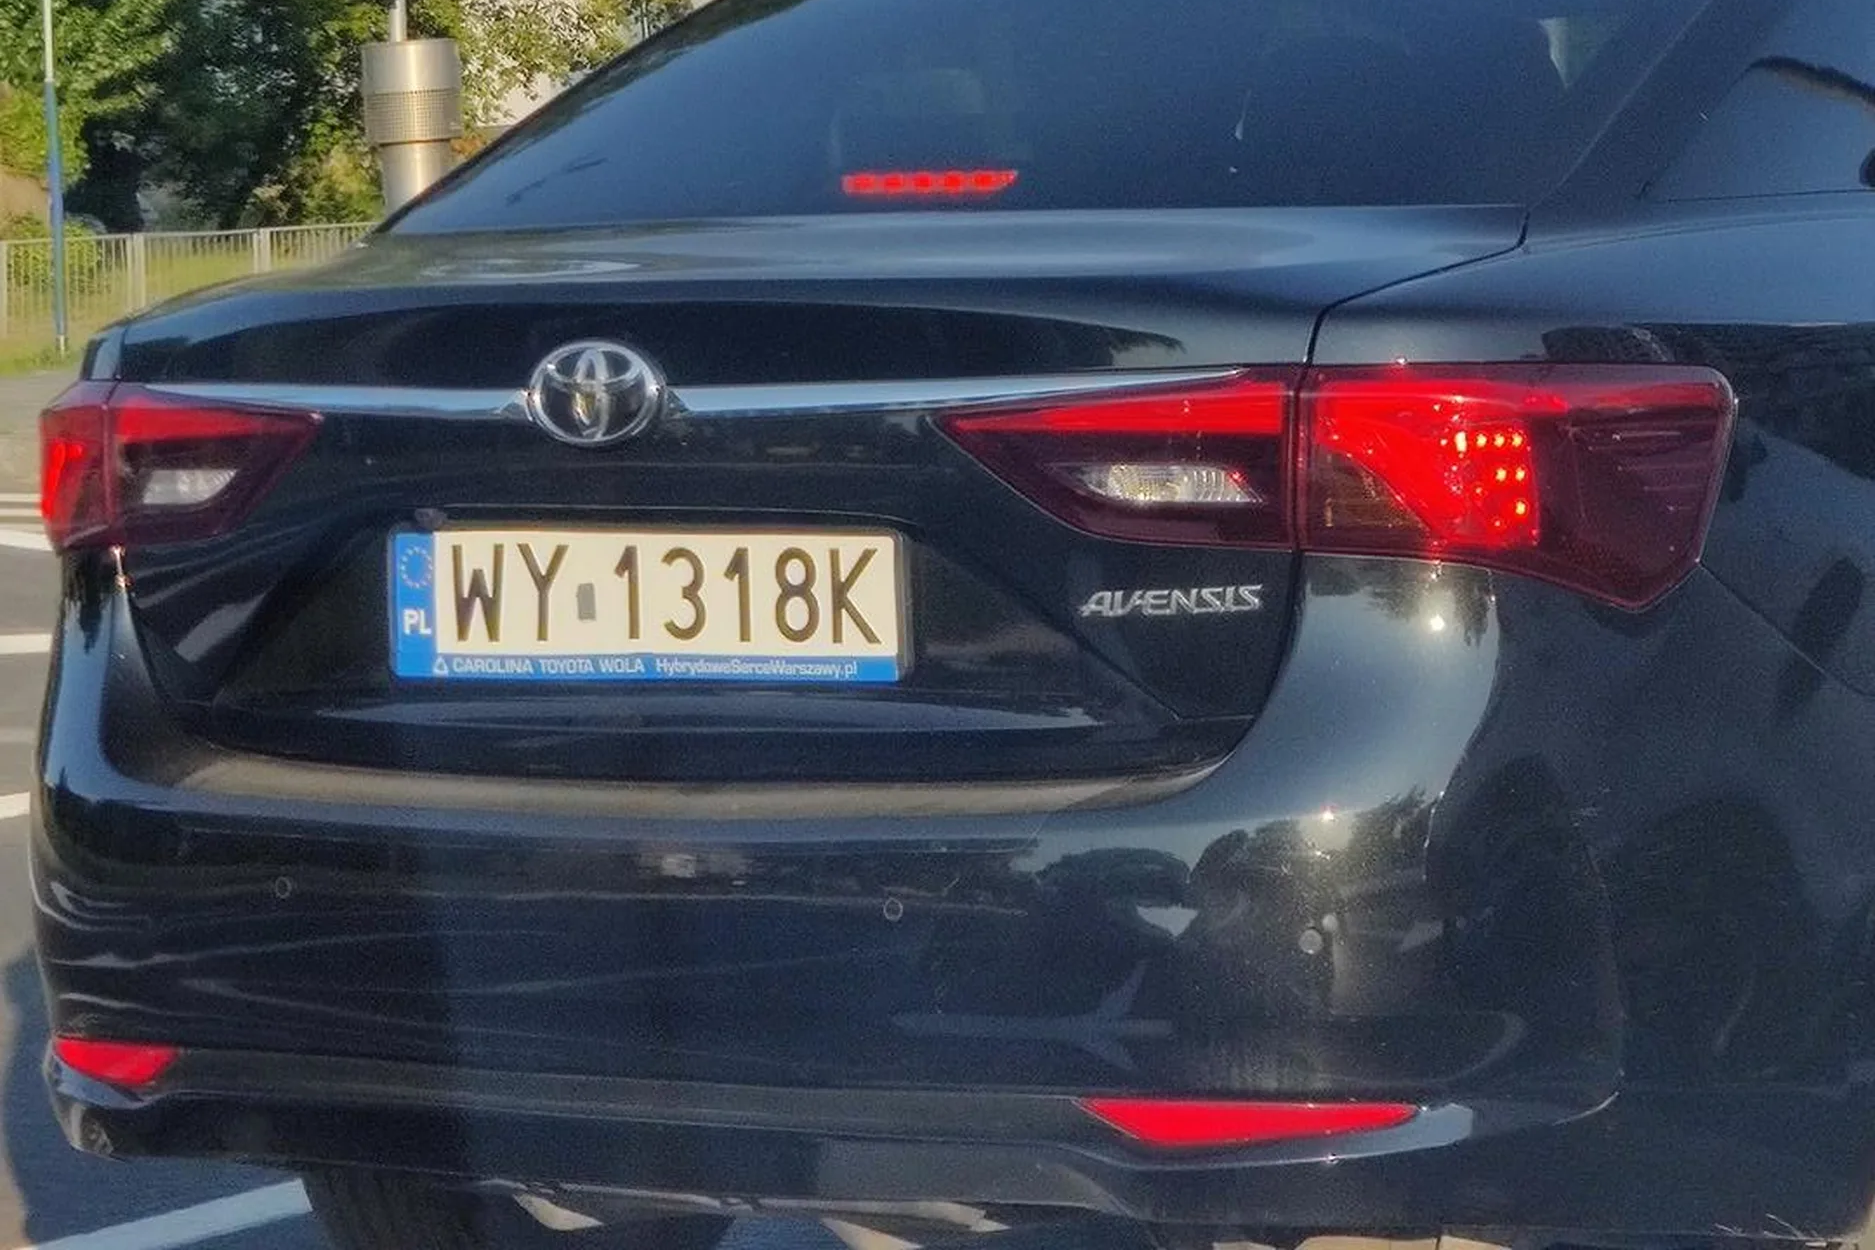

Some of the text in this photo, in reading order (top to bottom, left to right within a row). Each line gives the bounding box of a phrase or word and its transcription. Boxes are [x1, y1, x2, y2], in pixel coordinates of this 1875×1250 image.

[451, 543, 882, 644] WY 1318K
[1079, 584, 1263, 617] AVENSIS
[403, 609, 432, 635] PL
[453, 658, 532, 673] CAROLINA
[539, 658, 595, 674] TOYOTA
[600, 659, 645, 674] WOLA
